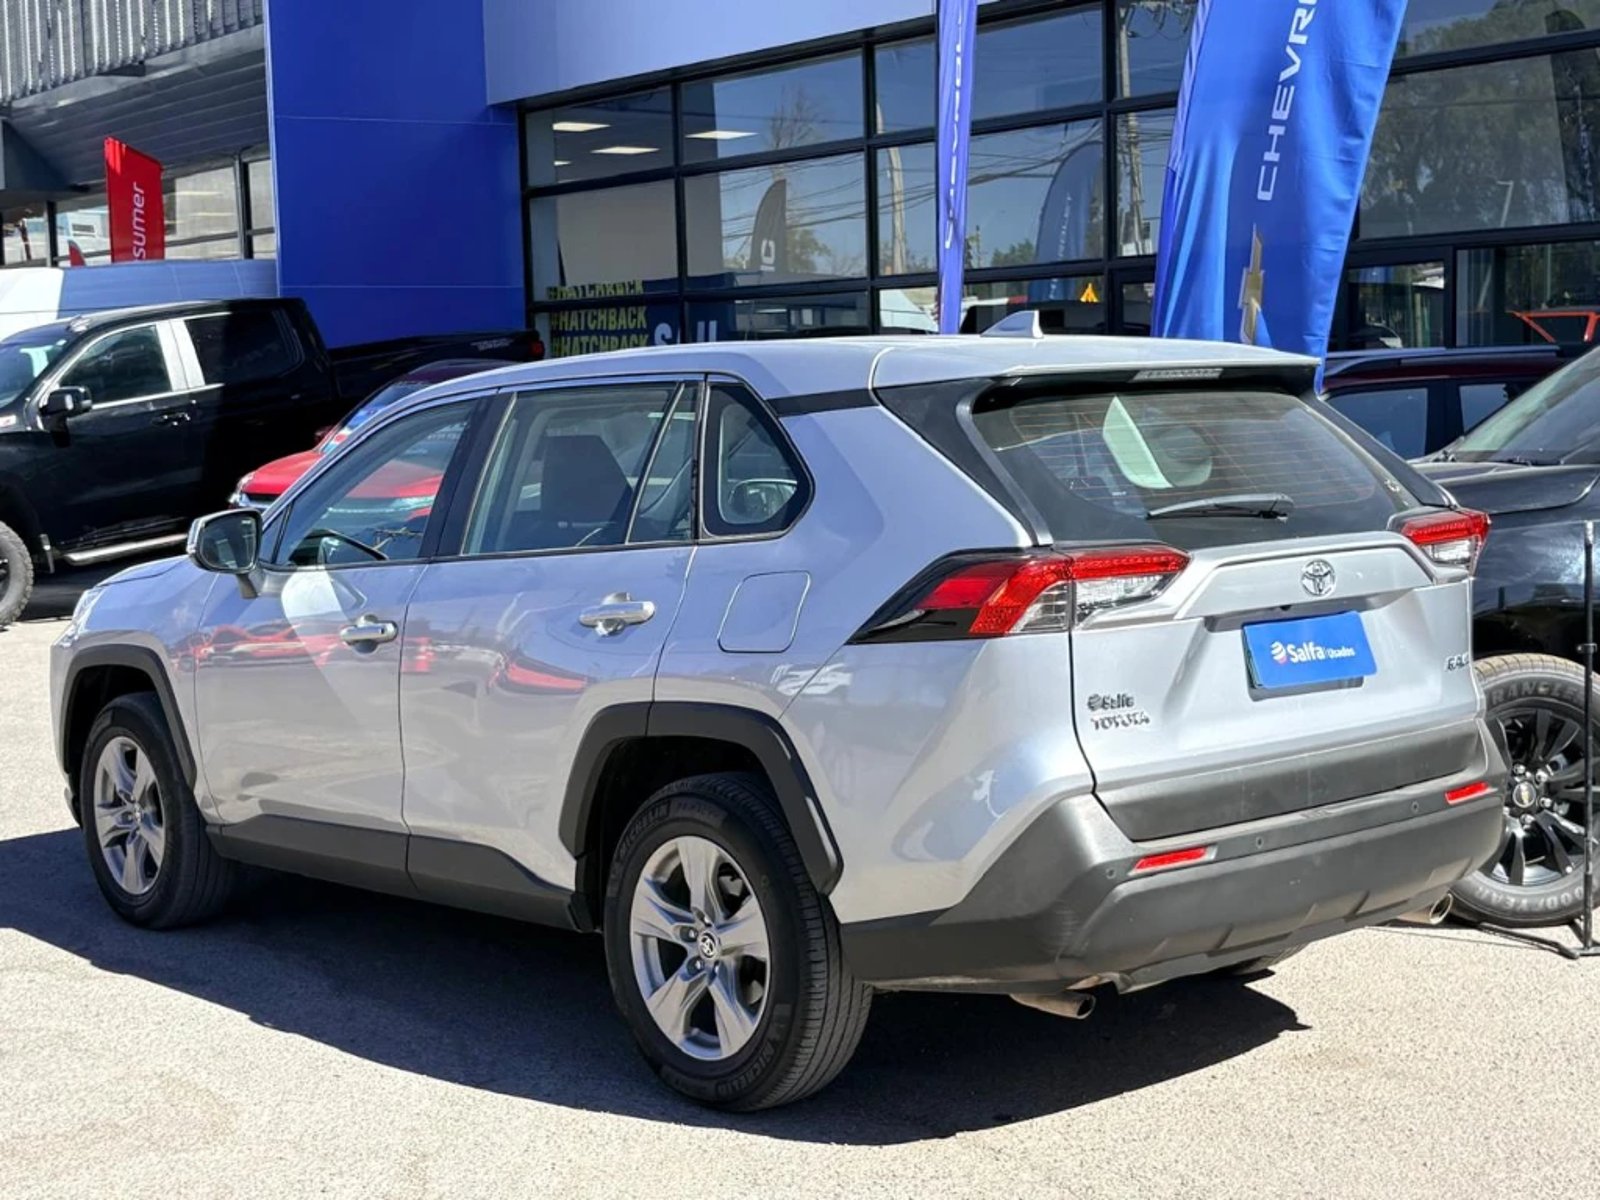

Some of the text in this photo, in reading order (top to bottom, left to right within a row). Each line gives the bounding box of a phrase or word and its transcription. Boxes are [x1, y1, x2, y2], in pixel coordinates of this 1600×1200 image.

[1256, 0, 1318, 201] CHEVR
[132, 181, 147, 261] sumer
[551, 306, 648, 331] #HATCHBACK
[1286, 642, 1325, 663] Salfa
[1090, 711, 1150, 731] TOYOTA
